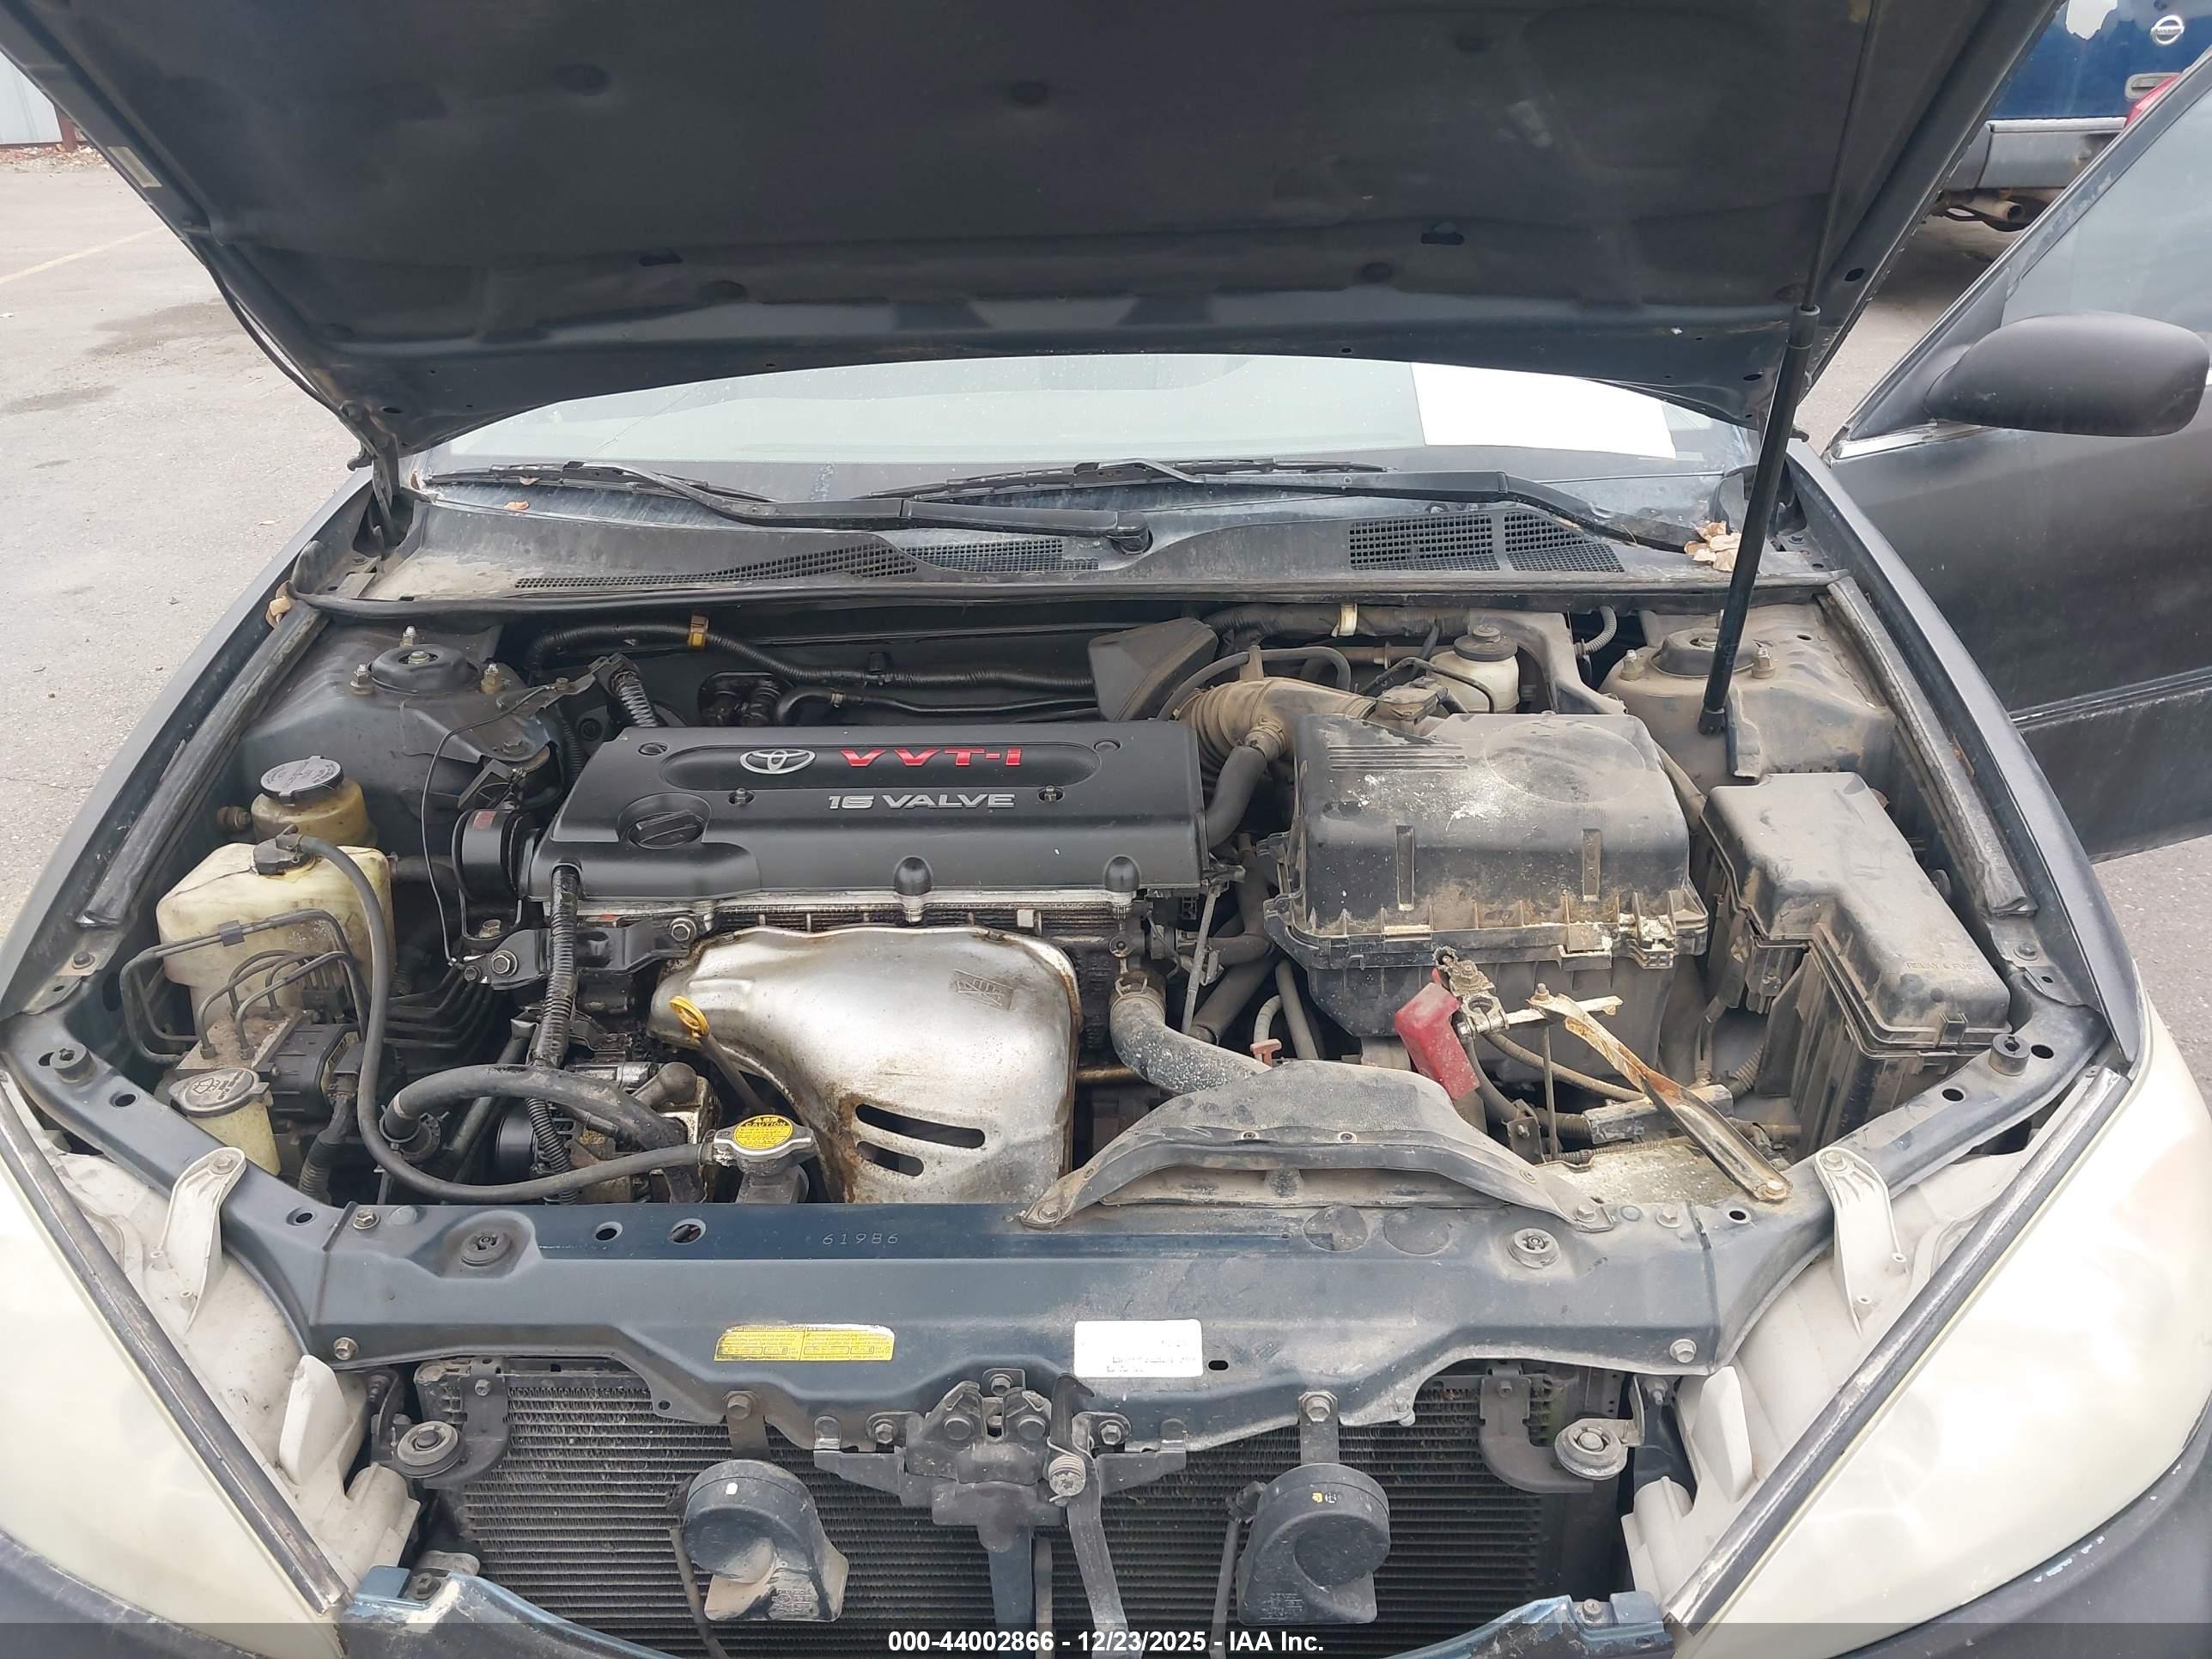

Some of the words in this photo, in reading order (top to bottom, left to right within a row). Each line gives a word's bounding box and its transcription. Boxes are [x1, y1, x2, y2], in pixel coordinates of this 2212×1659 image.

[829, 795, 874, 810] 16
[882, 793, 1016, 809] VALVE
[823, 1231, 899, 1245] 61986
